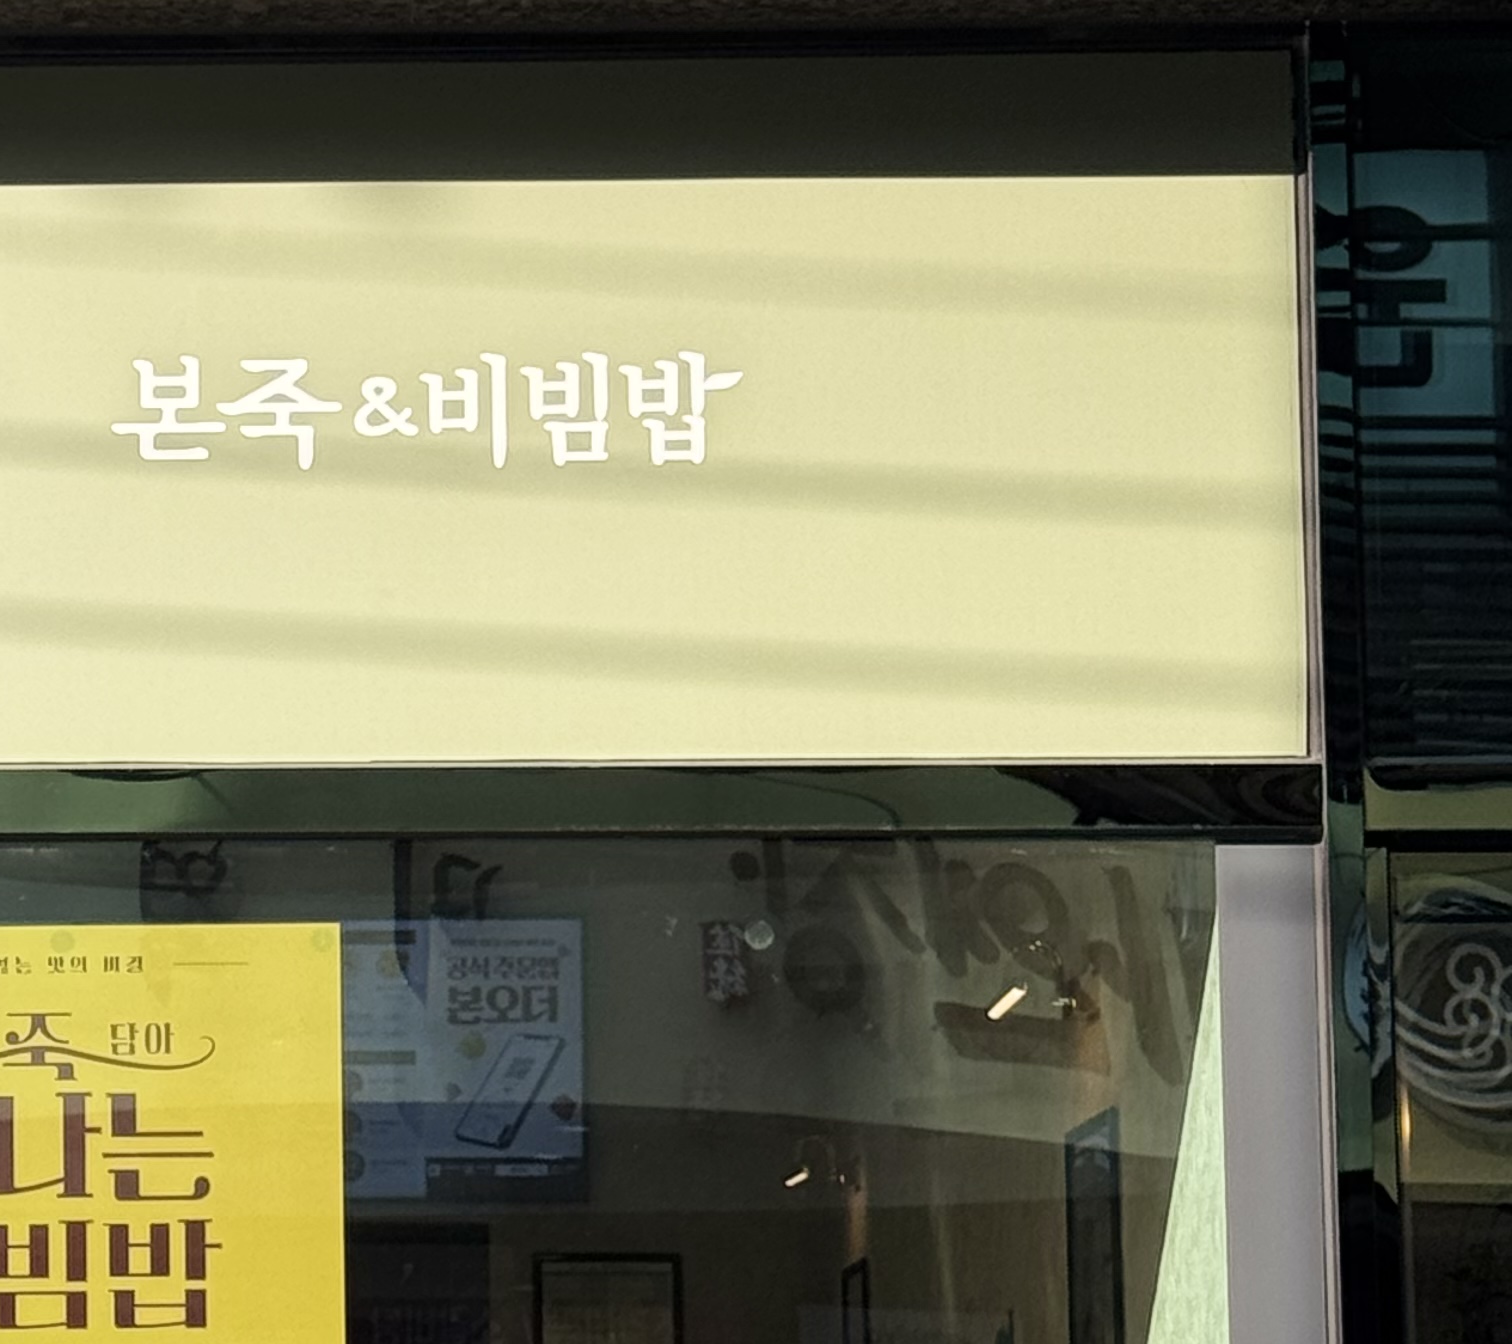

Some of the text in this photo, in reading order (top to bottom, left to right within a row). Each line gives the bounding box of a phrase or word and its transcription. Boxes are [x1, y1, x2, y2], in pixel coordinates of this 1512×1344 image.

[446, 984, 559, 1025] 본오더
[2, 1011, 79, 1081] 죽
[108, 1021, 176, 1057] 담아
